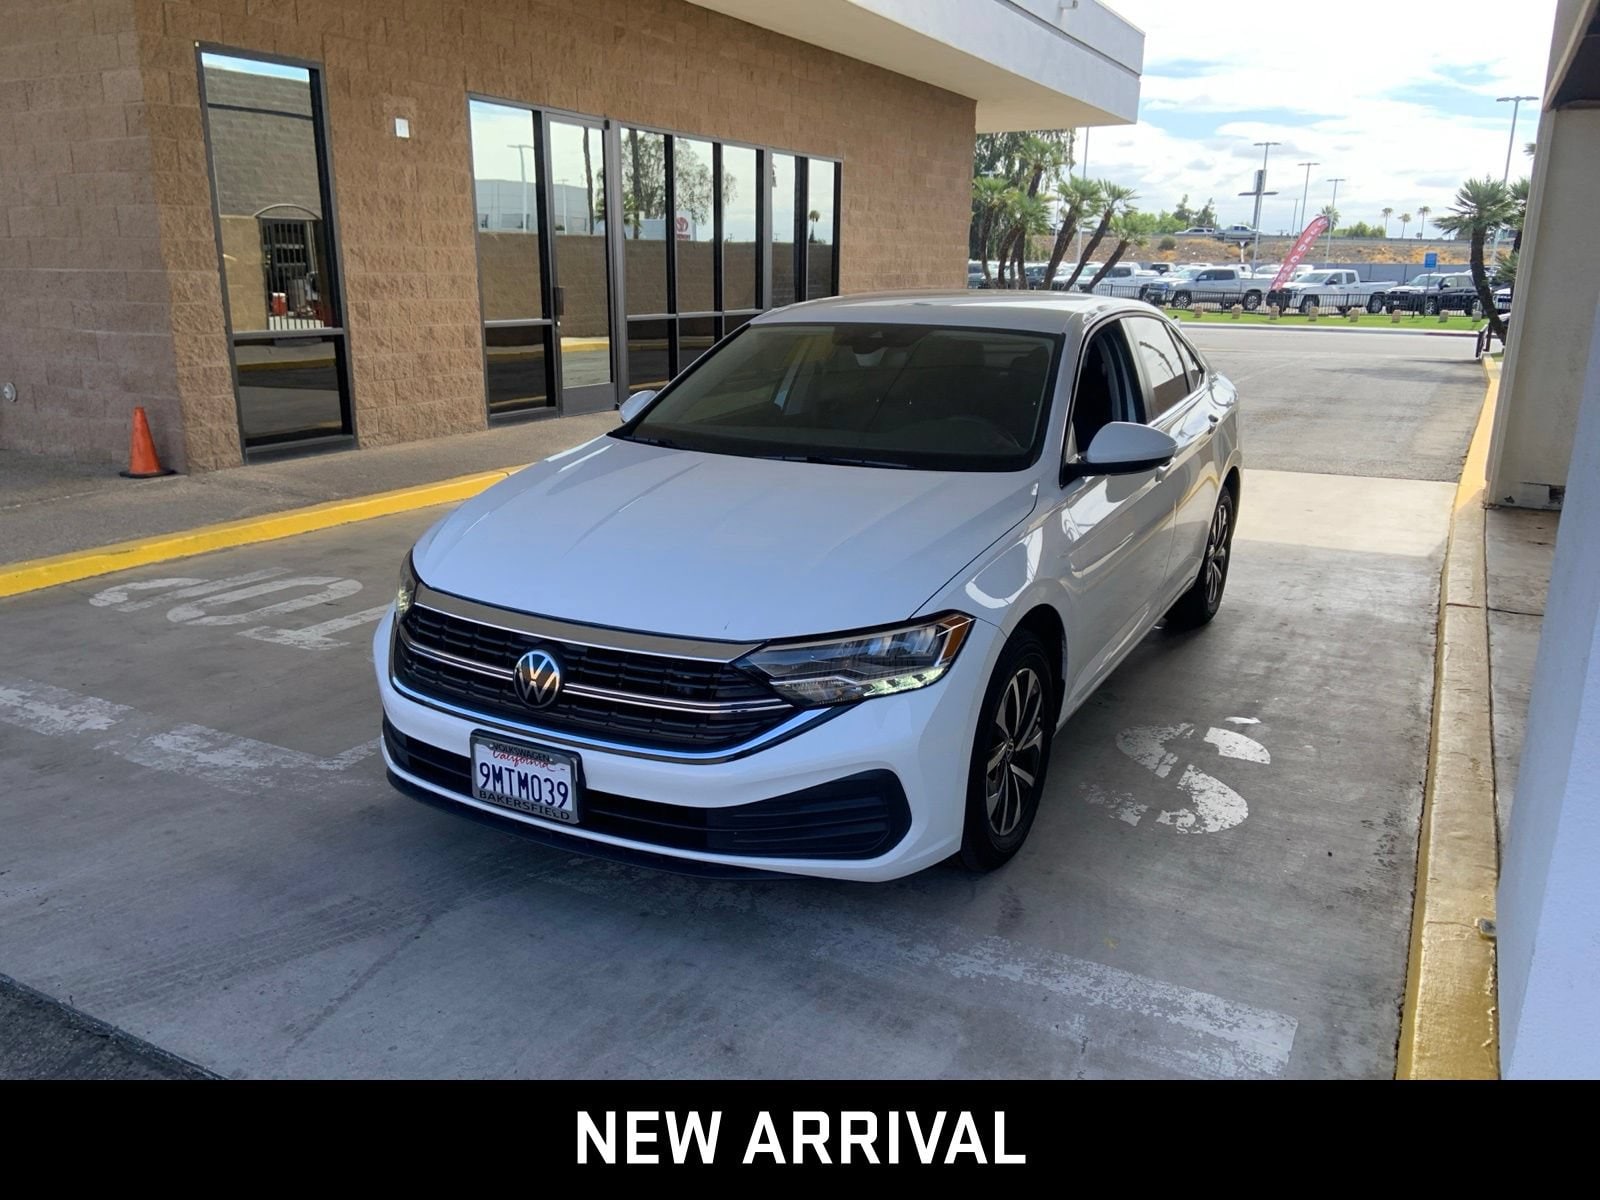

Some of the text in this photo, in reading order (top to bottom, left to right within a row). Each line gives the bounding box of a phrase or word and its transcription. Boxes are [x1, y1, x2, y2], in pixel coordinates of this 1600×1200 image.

[492, 742, 550, 761] VOLKSWAGEN
[479, 762, 569, 808] 9MTM039
[479, 790, 570, 820] BAKERSFIELD
